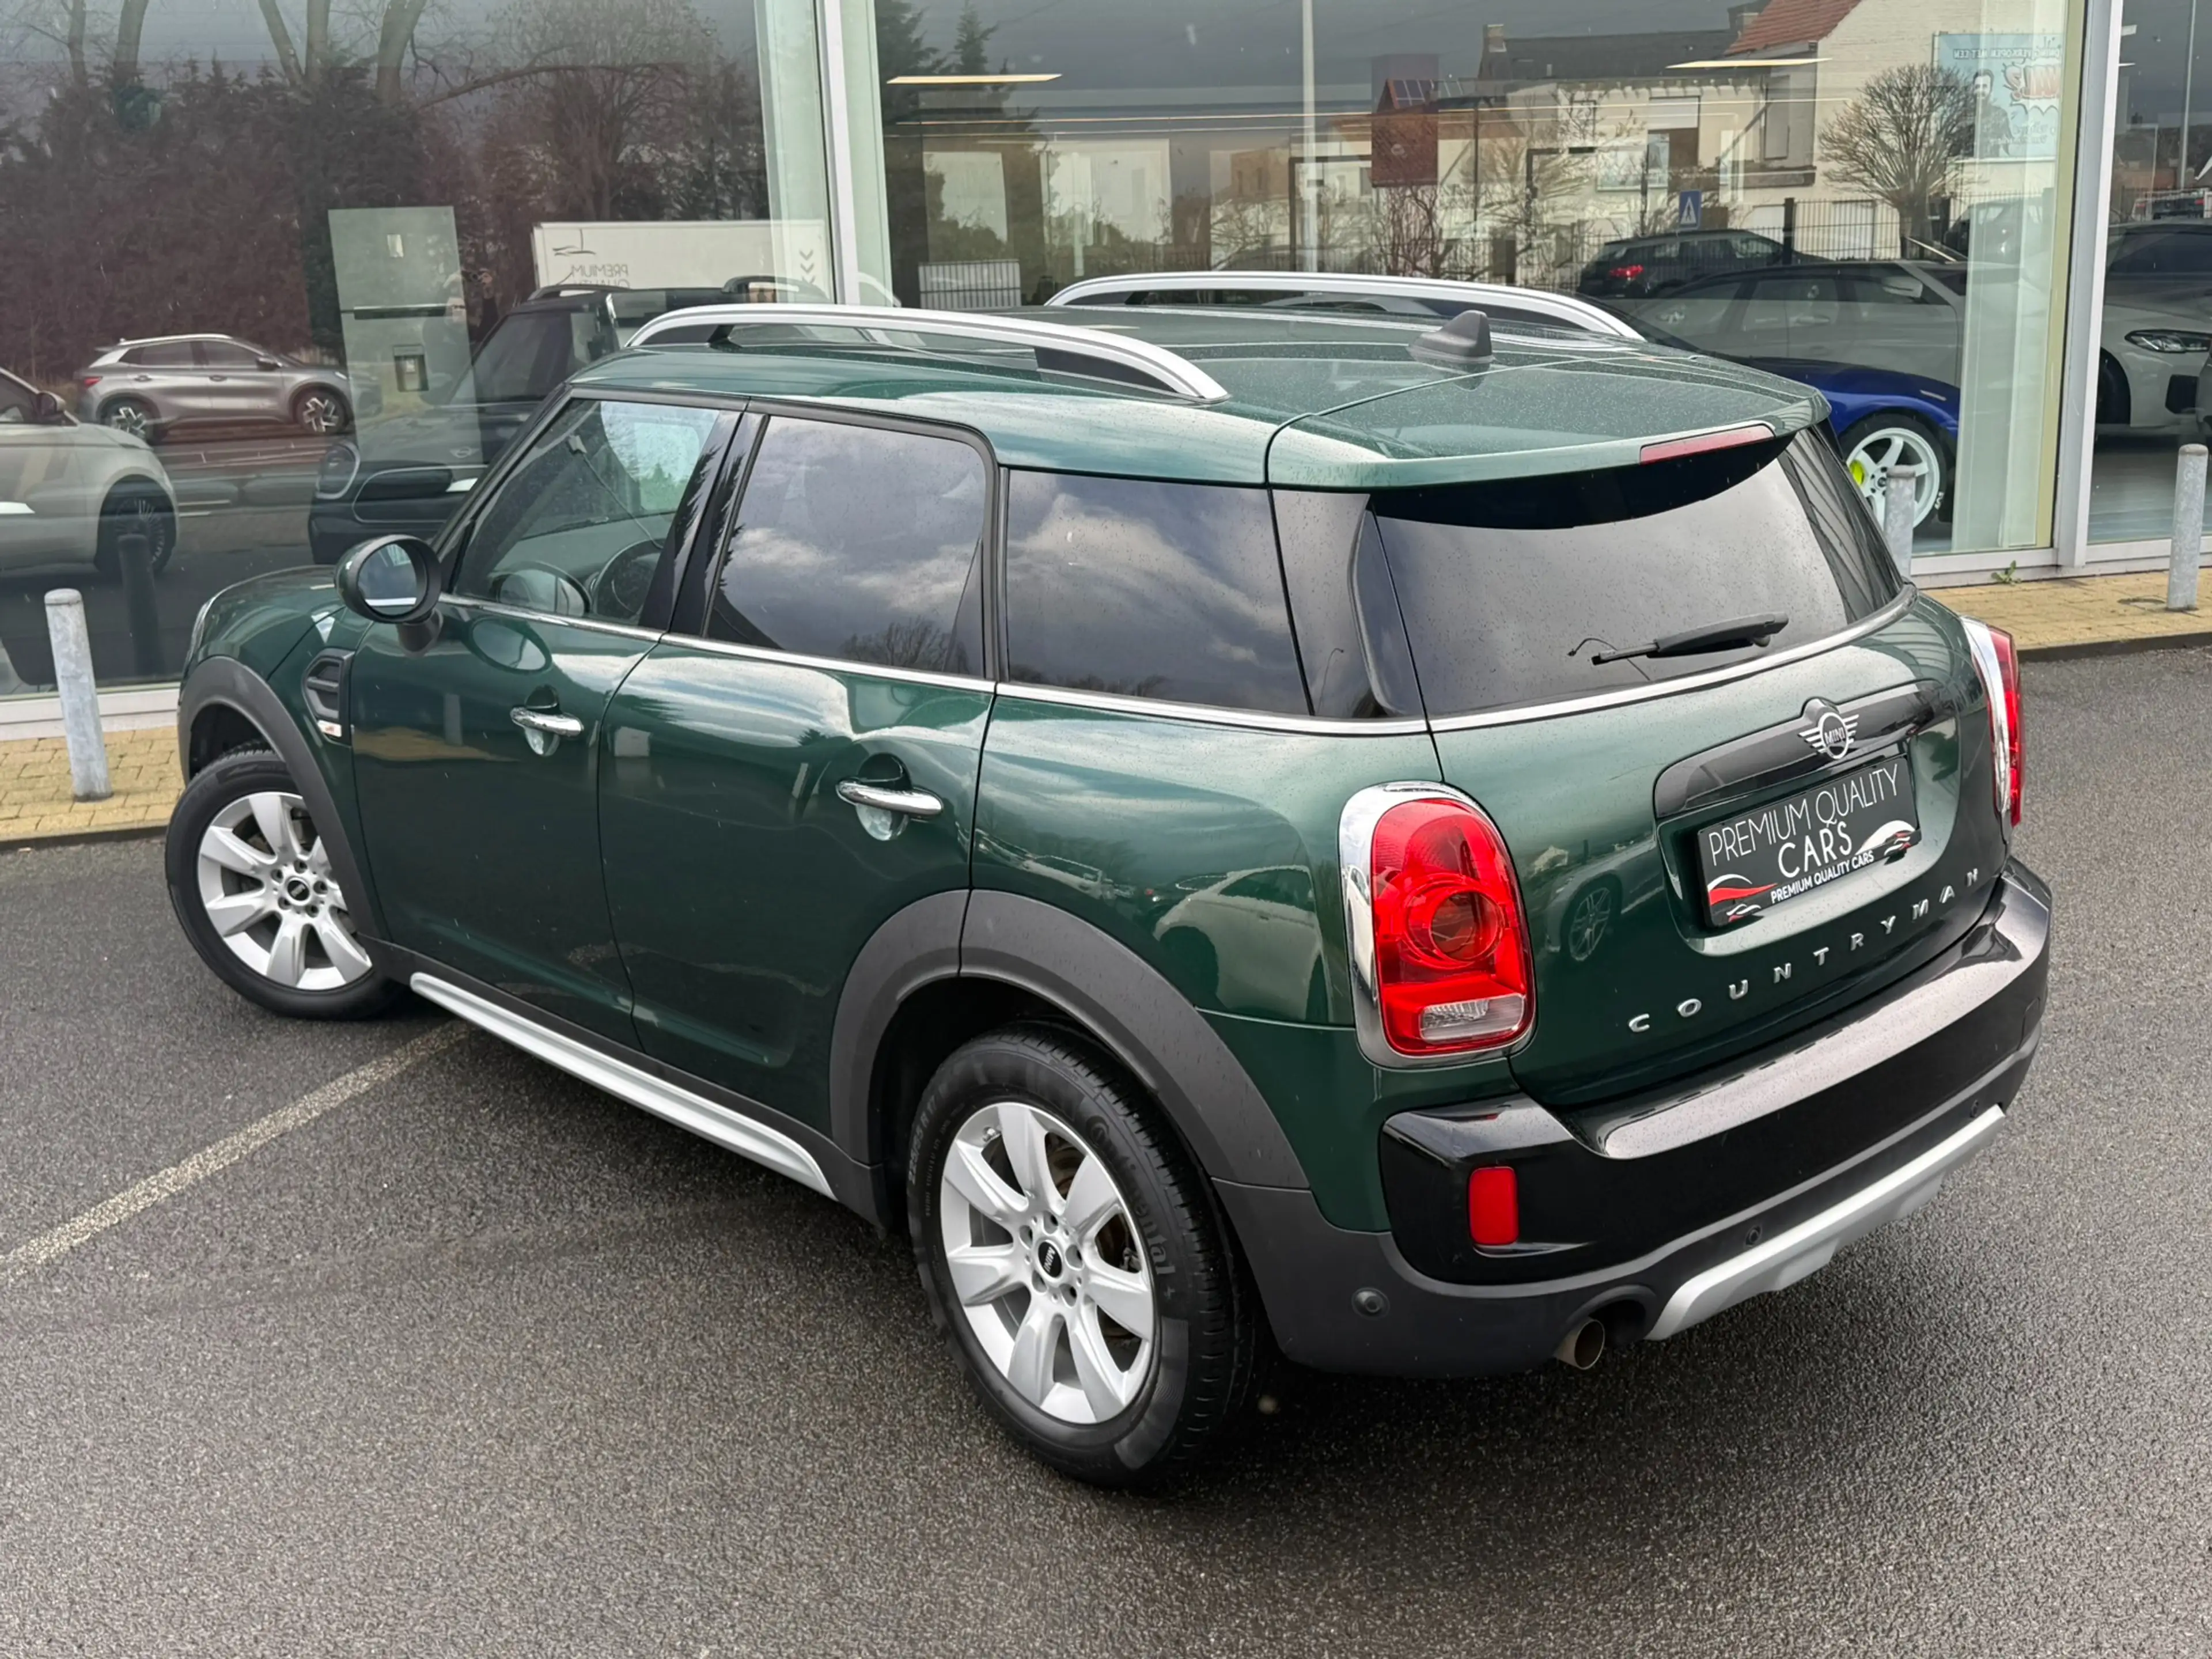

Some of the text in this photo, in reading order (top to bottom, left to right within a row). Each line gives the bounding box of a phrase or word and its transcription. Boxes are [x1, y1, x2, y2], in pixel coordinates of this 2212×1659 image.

[1824, 727, 1846, 744] MINI
[1709, 763, 1898, 866] PREMIUM QUALITY
[1770, 850, 1875, 904] PREMIUM QUALITY CARS
[1778, 820, 1852, 878] CARS
[1628, 868, 1979, 1033] COUNTRYMAN
[1043, 1246, 1056, 1274] MINI
